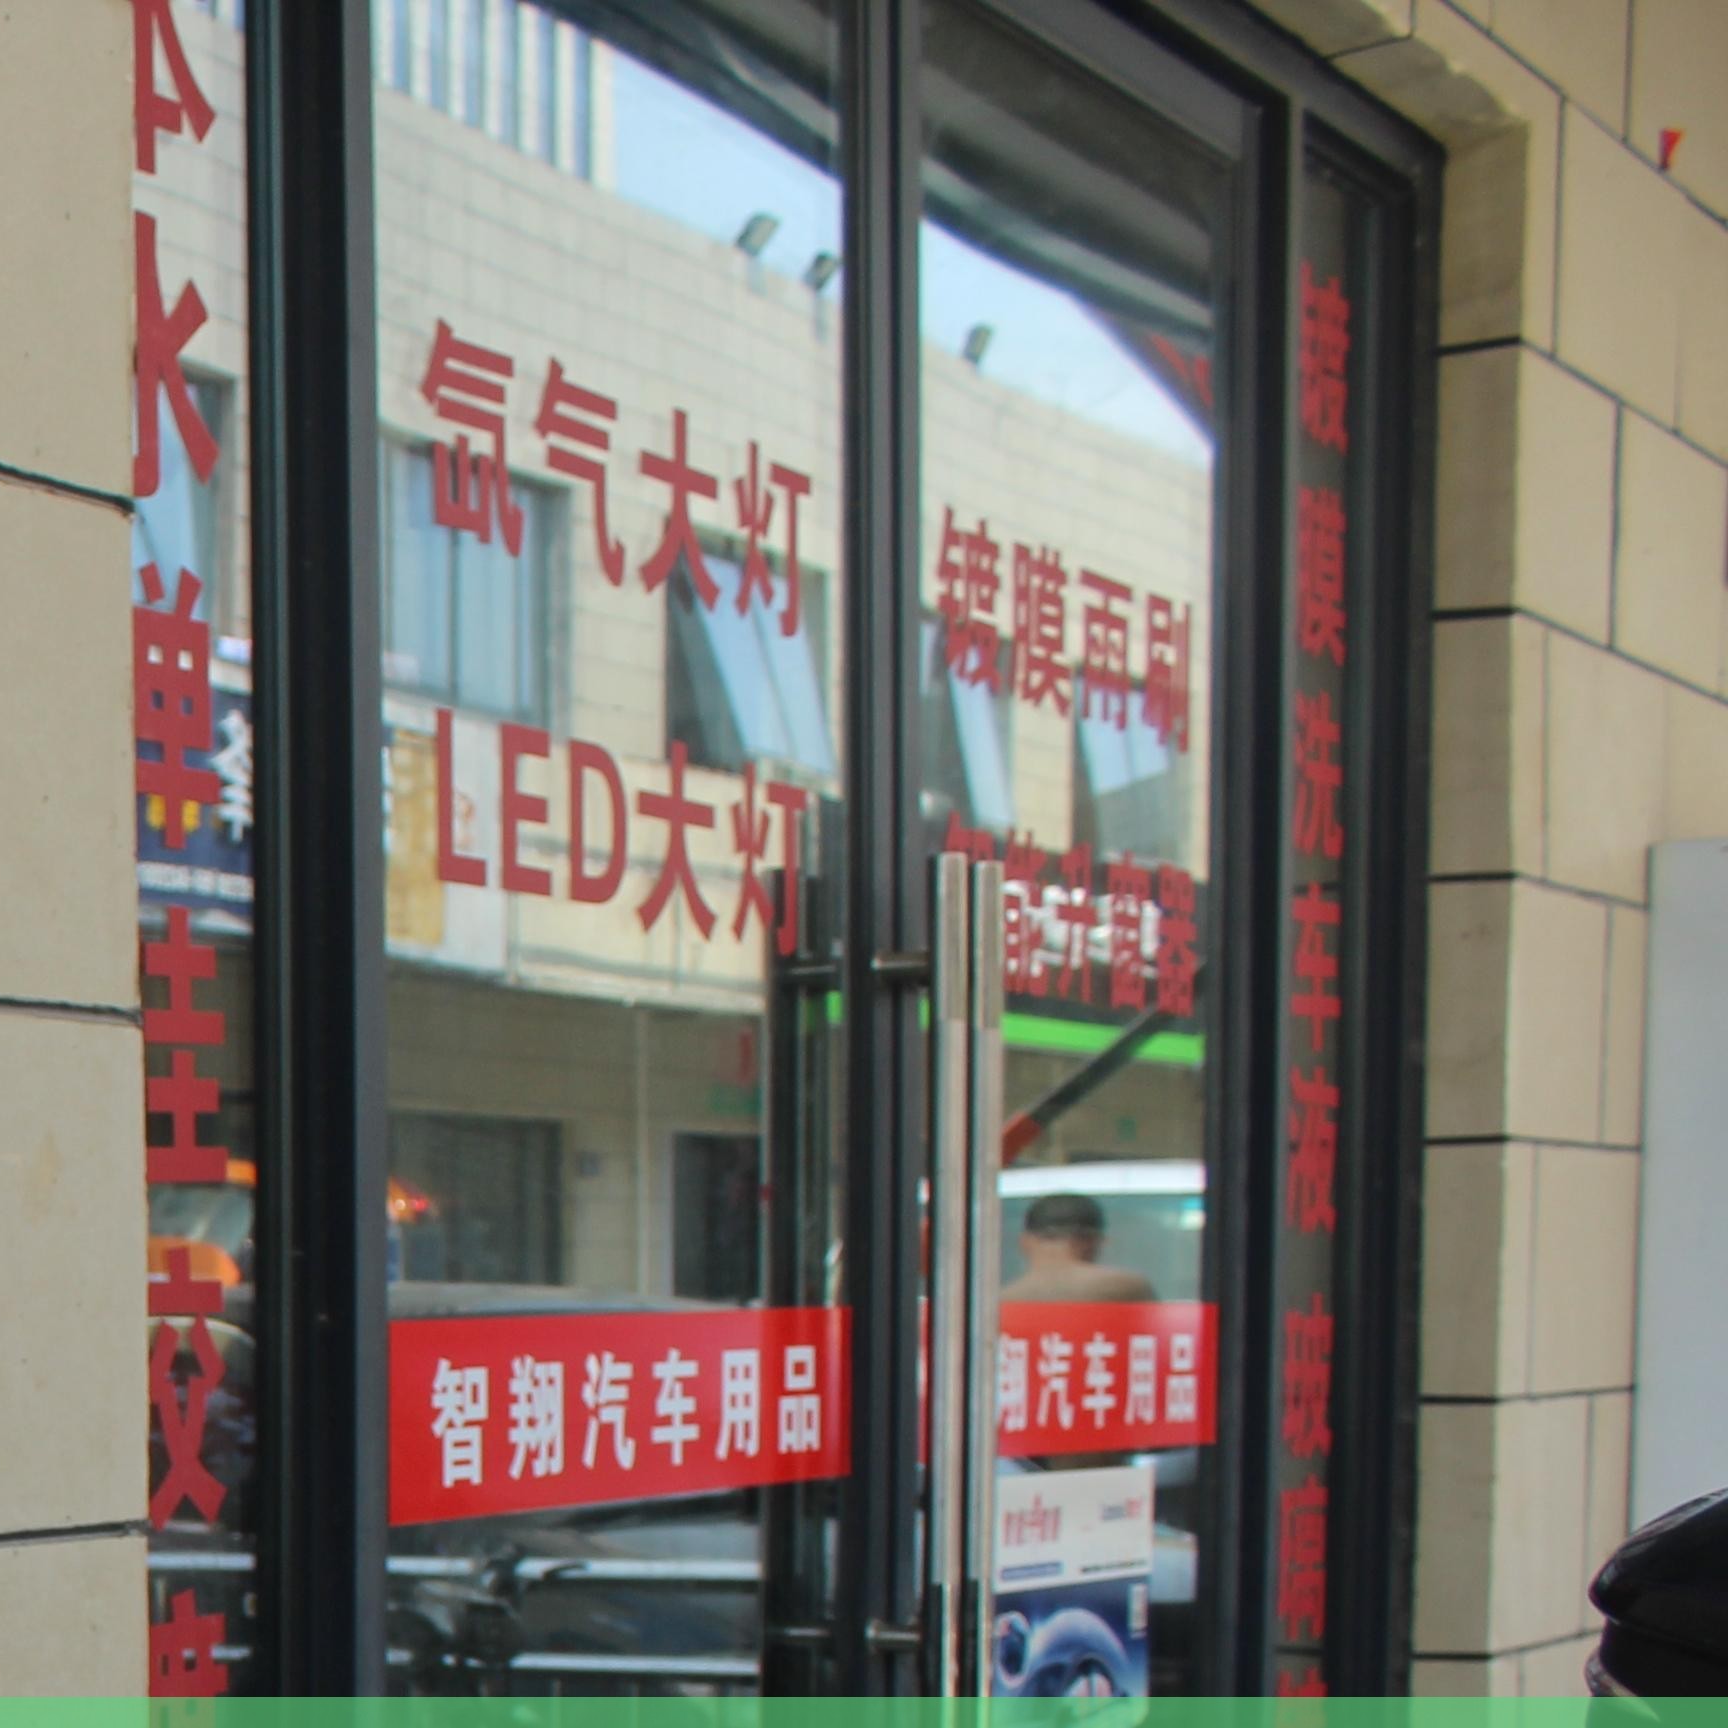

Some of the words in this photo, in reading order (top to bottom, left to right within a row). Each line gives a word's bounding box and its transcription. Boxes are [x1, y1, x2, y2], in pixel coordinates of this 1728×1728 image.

[419, 316, 811, 638] 氙气大灯
[936, 504, 1191, 753] 镀膜雨刷
[435, 708, 807, 958] LED大灯
[429, 1321, 825, 1487] 智翔汽车用品
